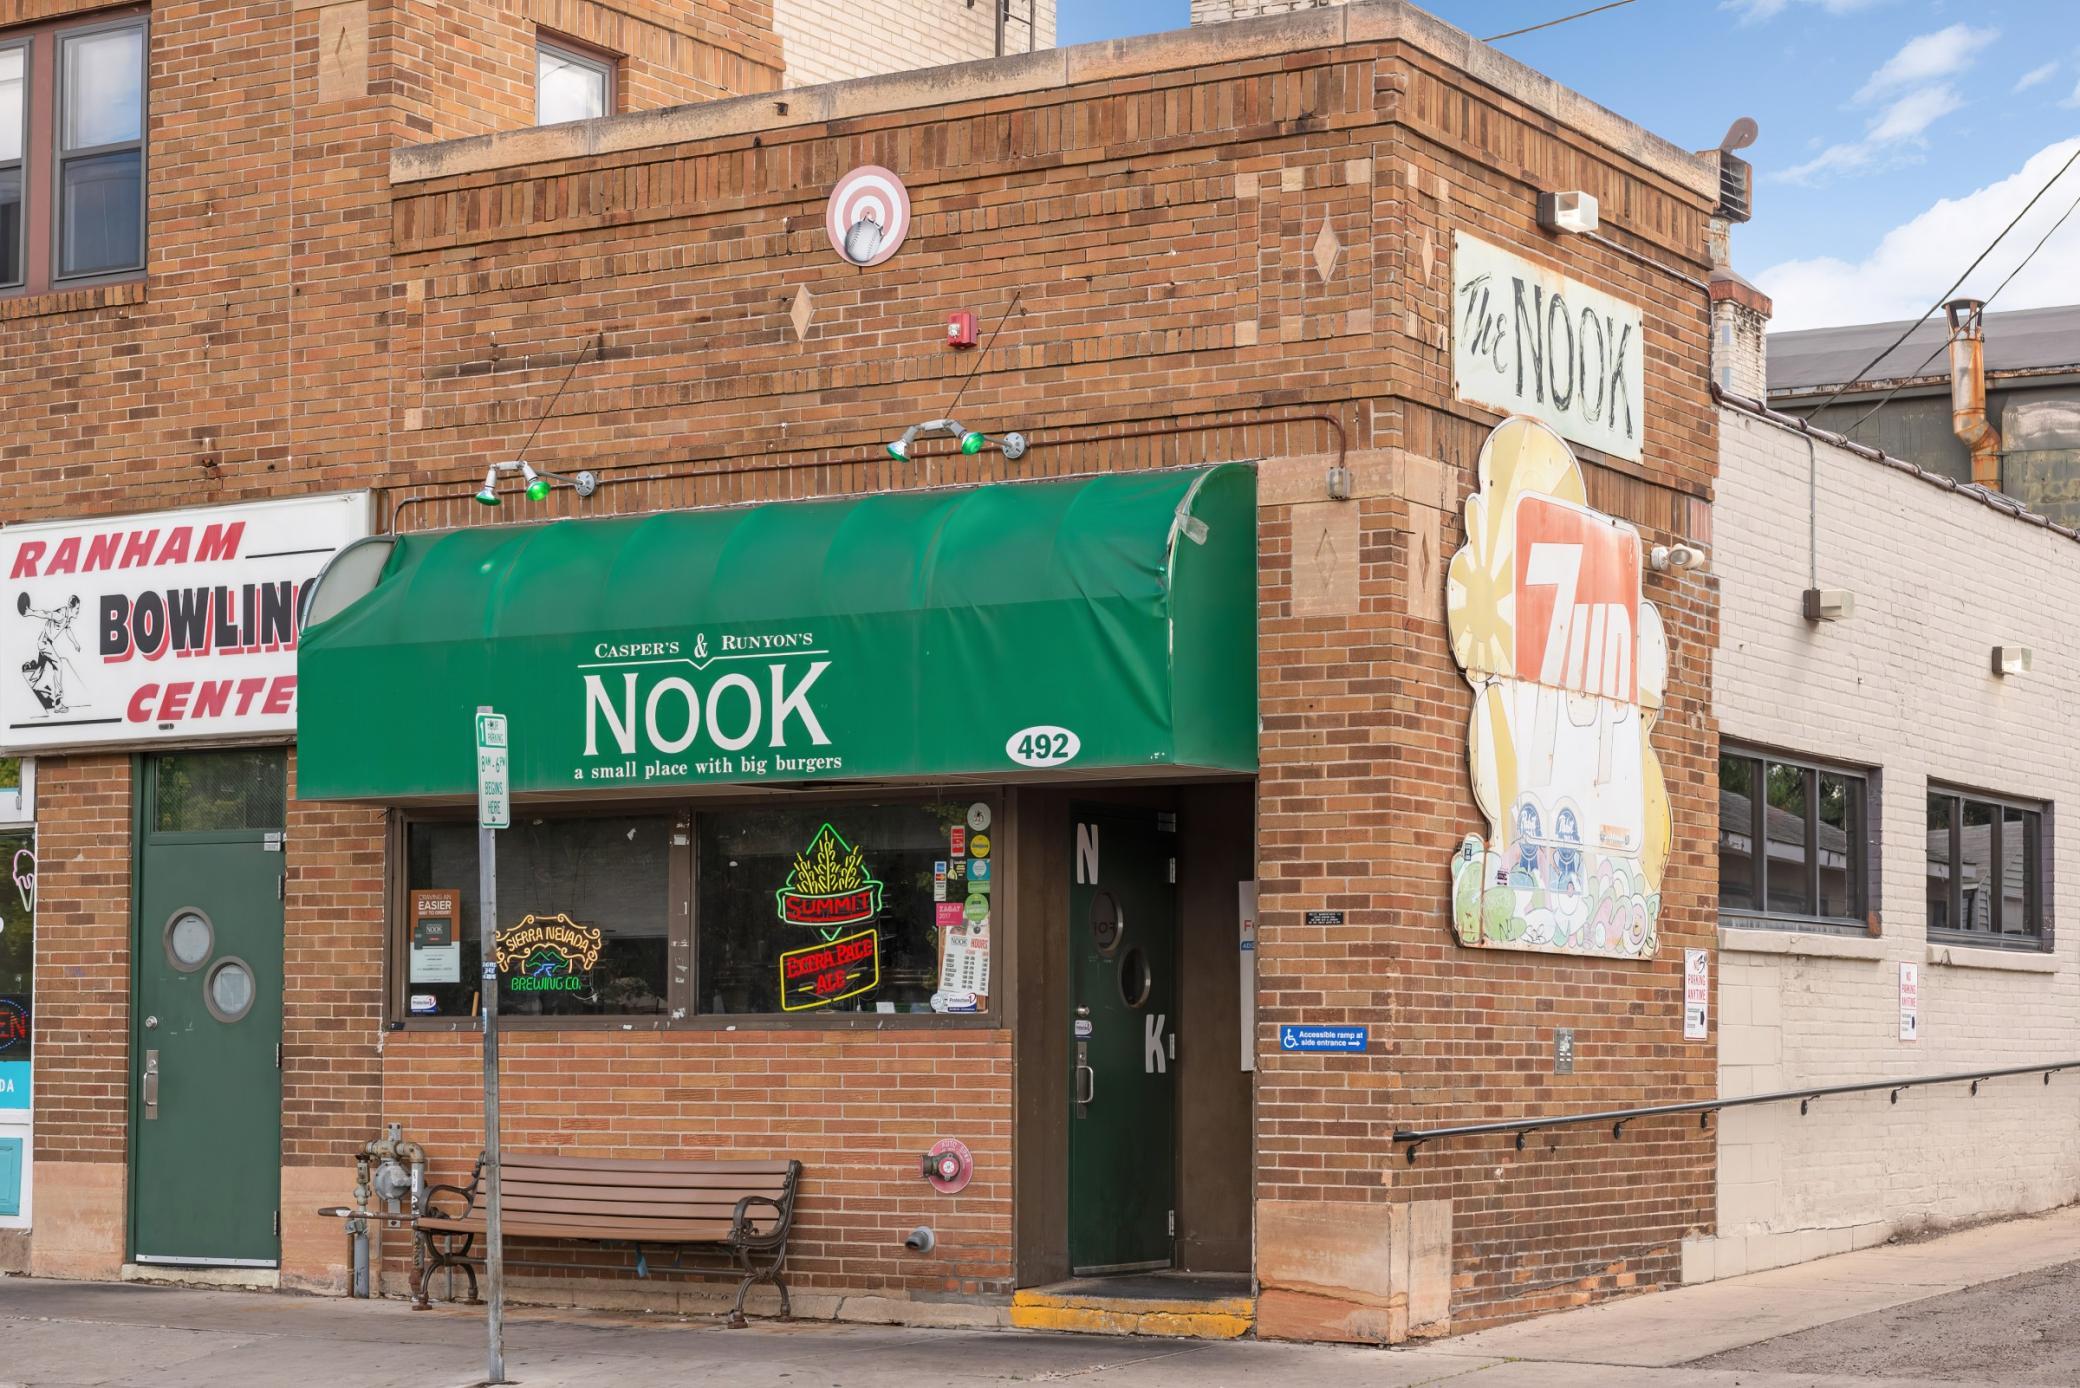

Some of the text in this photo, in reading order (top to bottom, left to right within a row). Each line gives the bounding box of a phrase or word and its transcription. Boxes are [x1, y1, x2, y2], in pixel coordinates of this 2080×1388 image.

[1512, 276, 1634, 440] NOOK
[9, 521, 247, 579] RANHAM
[594, 632, 814, 659] CASPER'S & RUNYON'S
[126, 675, 297, 723] CENTE
[583, 660, 833, 756] NOOK
[1016, 733, 1070, 760] 492
[574, 753, 842, 780] a small place with big burgers
[484, 781, 503, 796] BEGINS
[487, 800, 501, 815] HERE
[1076, 823, 1099, 885] N
[418, 900, 452, 910] EASIER
[786, 892, 872, 918] SUMMIT
[505, 926, 589, 955] SIERRA NEVADA
[786, 938, 874, 979] EXTRA PALE
[511, 976, 581, 991] BREWING CO.
[815, 970, 846, 995] ALE
[1688, 975, 1706, 986] PARKING
[1688, 989, 1706, 1000] ANYTIME
[1145, 1014, 1167, 1073] K
[1299, 1030, 1364, 1040] Accessible ramp at
